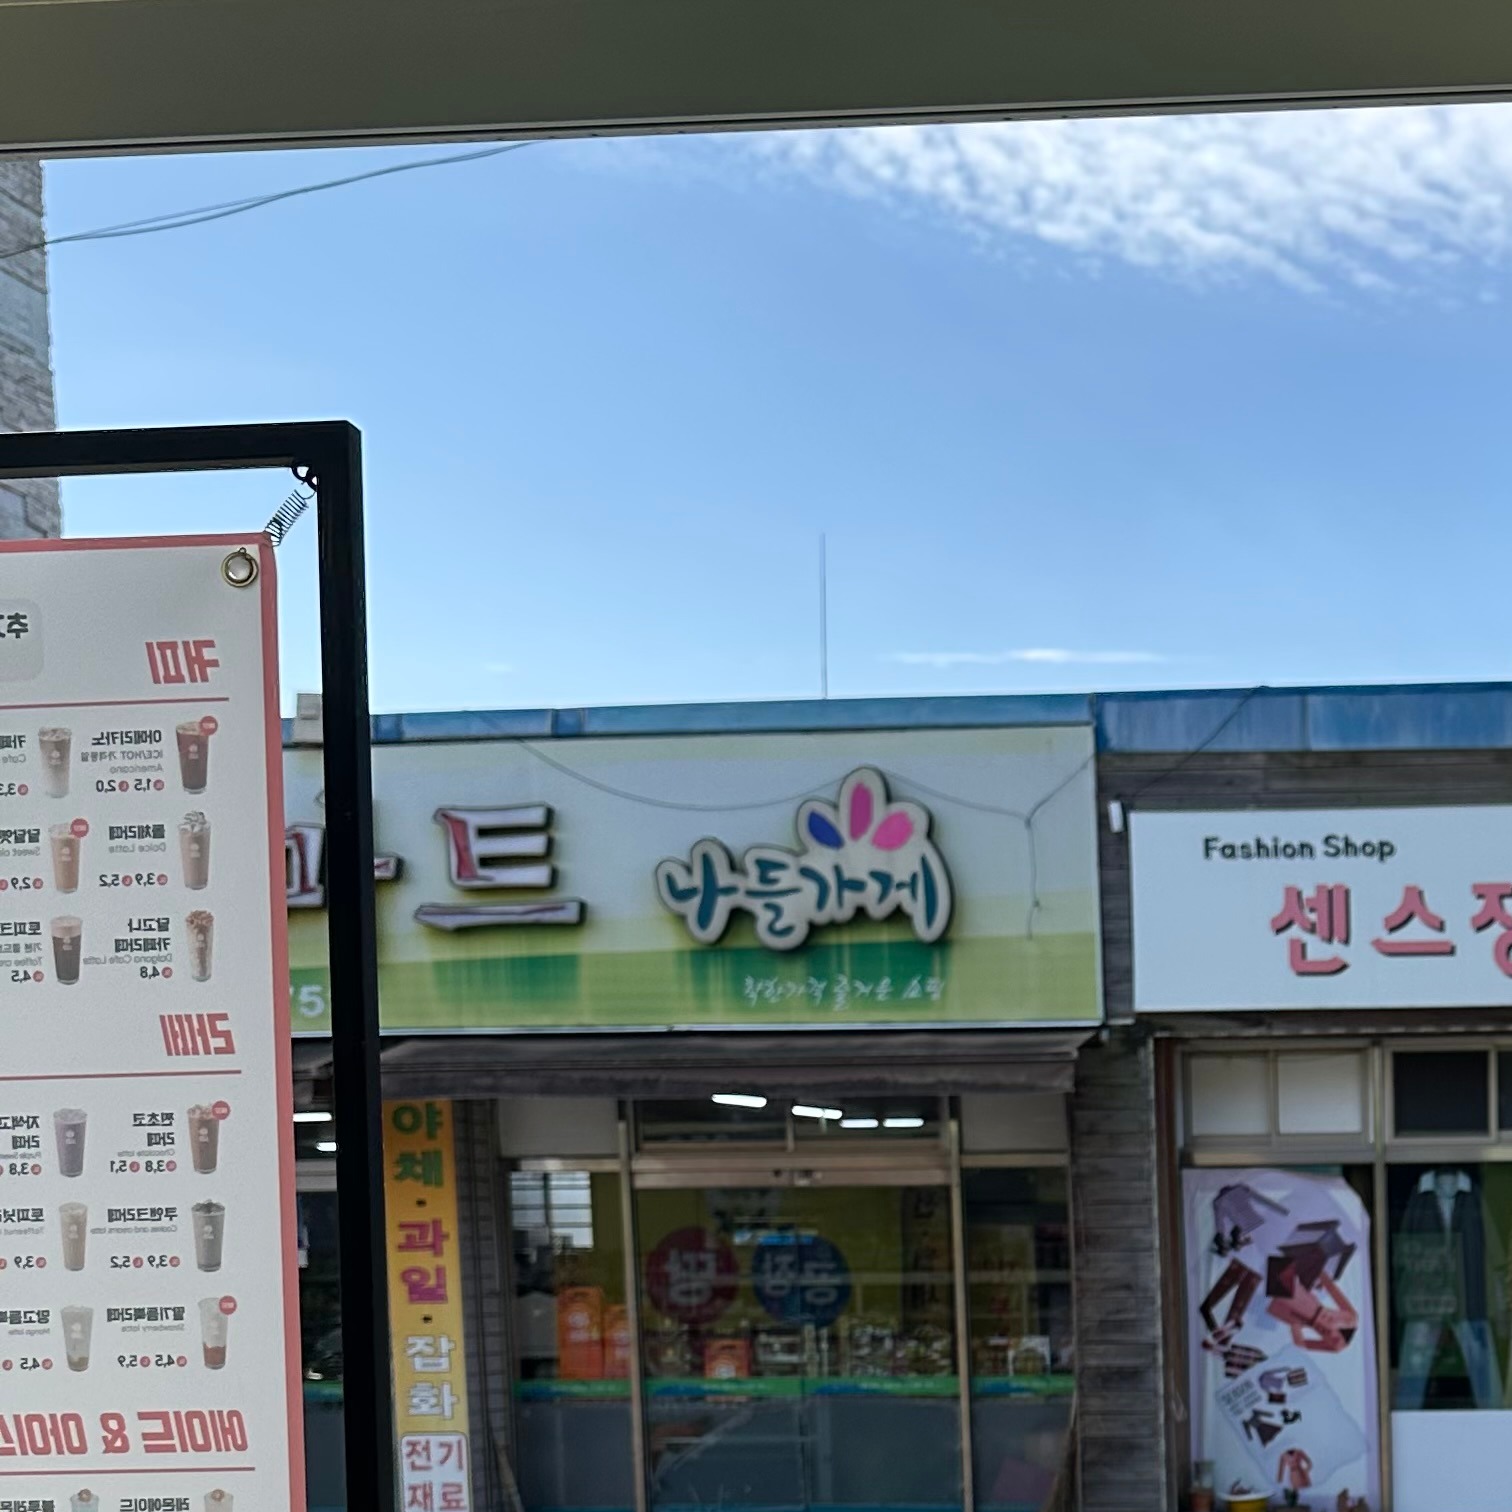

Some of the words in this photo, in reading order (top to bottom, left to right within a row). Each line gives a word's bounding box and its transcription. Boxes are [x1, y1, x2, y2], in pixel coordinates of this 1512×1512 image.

[1203, 835, 1316, 861] Fashion
[1322, 833, 1397, 864] Shop
[664, 838, 938, 944] 나들가게
[405, 1438, 465, 1473] 전기
